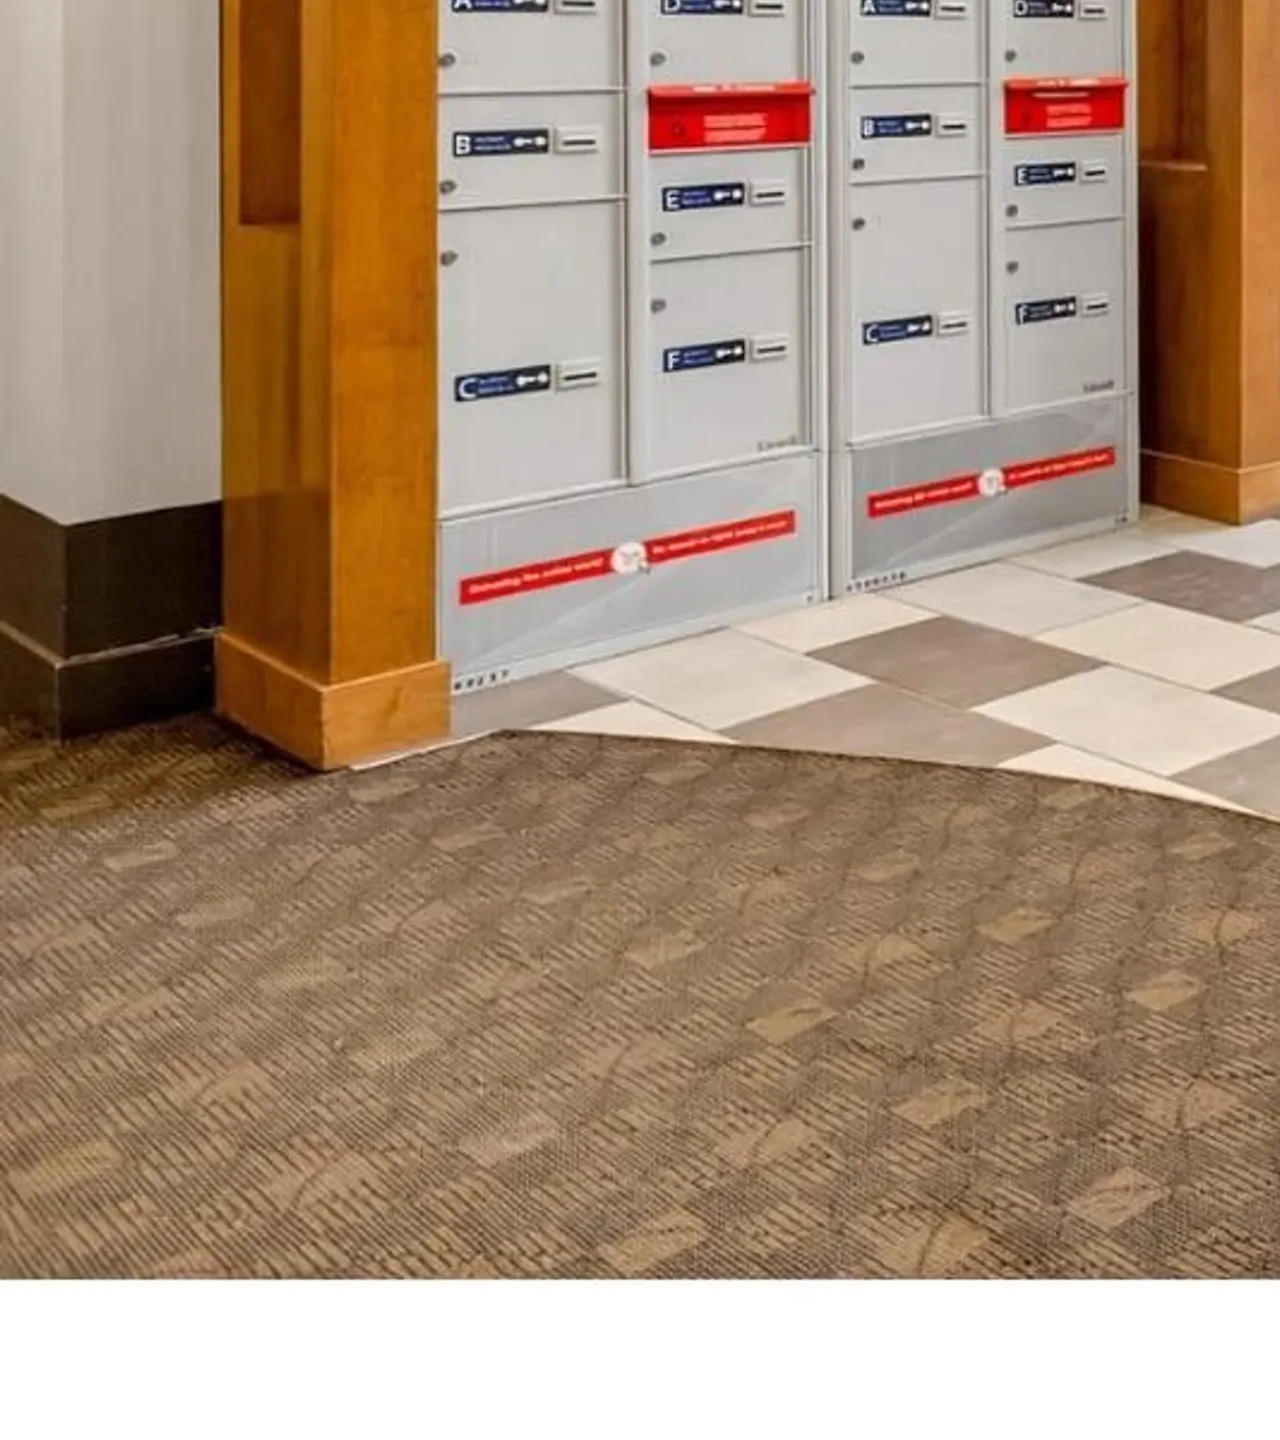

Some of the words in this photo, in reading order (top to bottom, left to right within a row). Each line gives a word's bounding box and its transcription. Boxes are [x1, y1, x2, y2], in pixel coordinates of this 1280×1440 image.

[455, 135, 472, 154] B
[666, 190, 681, 210] E
[667, 351, 682, 370] F
[459, 378, 478, 399] C
